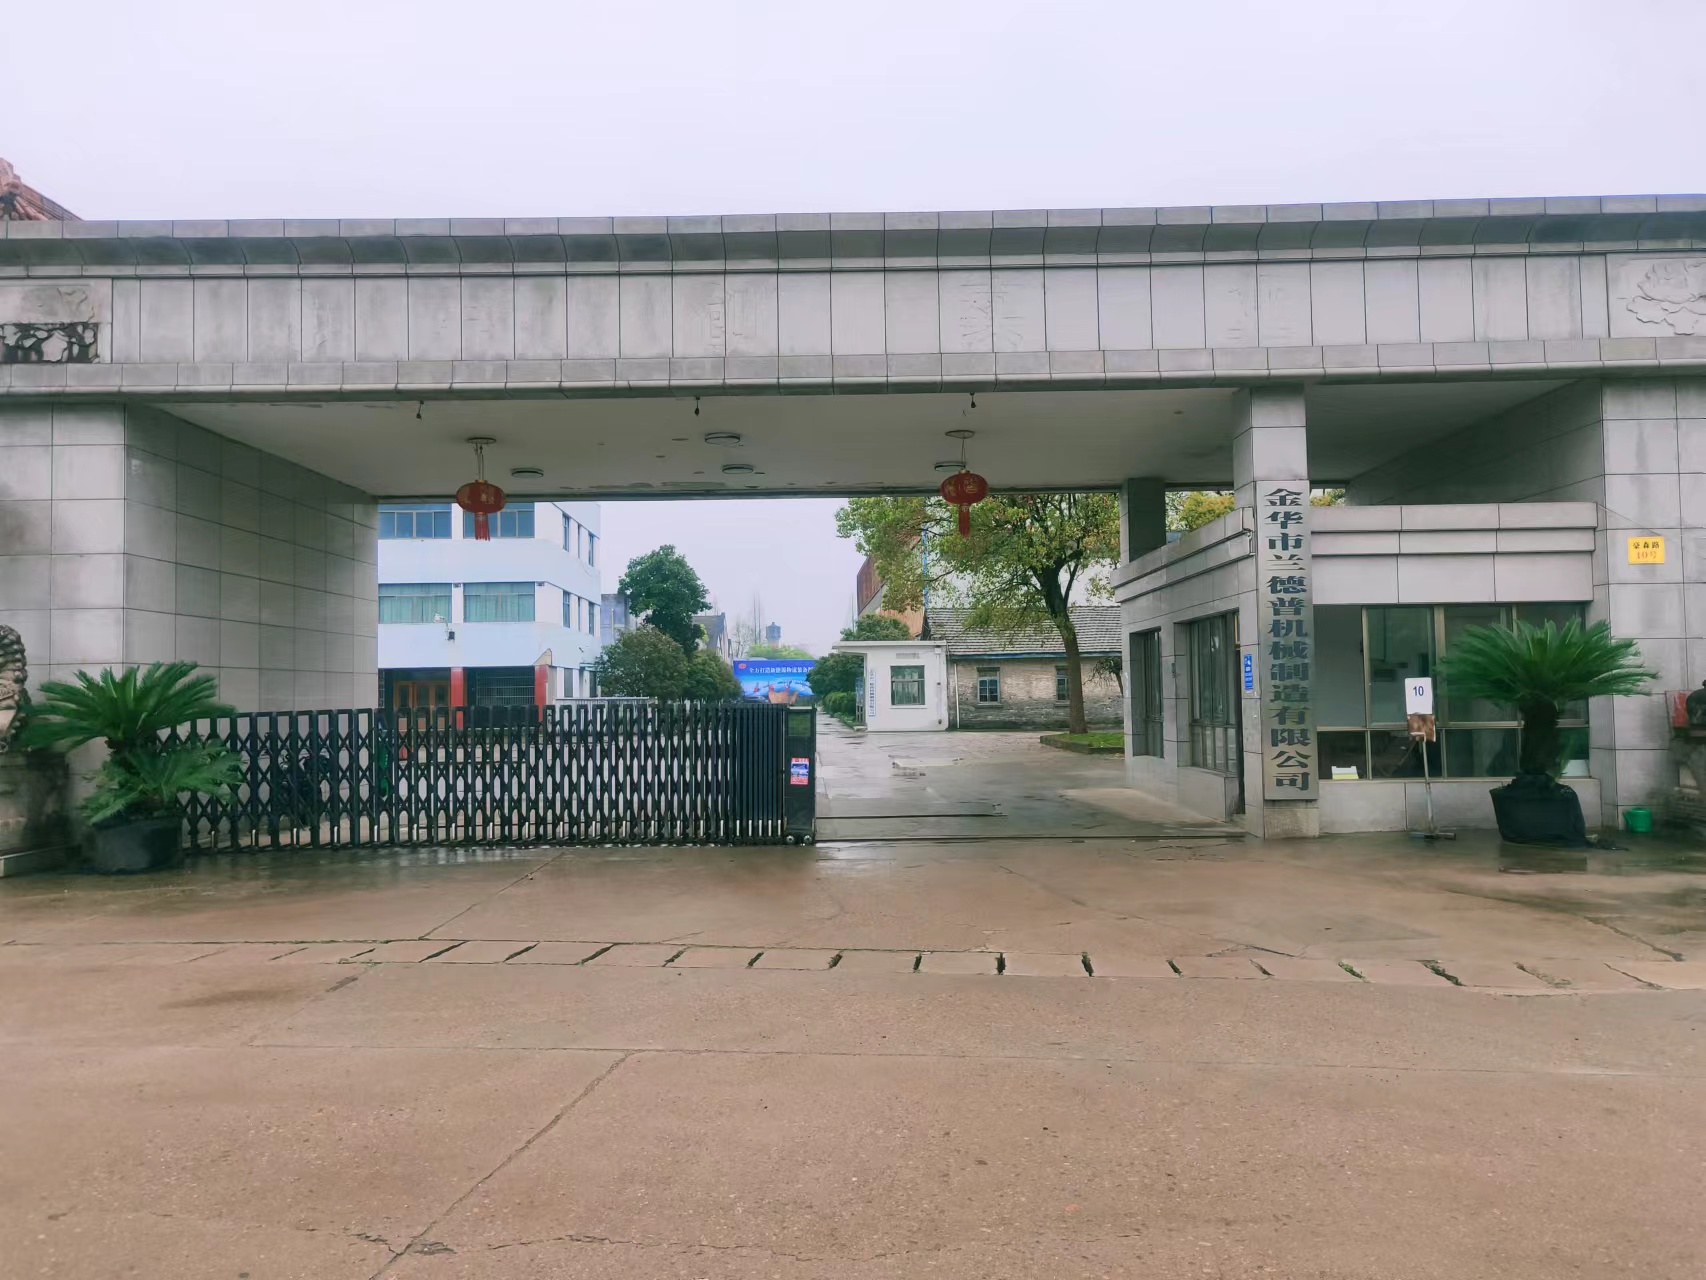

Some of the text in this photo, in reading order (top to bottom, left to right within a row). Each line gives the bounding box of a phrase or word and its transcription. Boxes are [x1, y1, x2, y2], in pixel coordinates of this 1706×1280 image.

[1264, 488, 1312, 791] 金华市兰德普机械制造有限公司
[1413, 685, 1424, 697] 10
